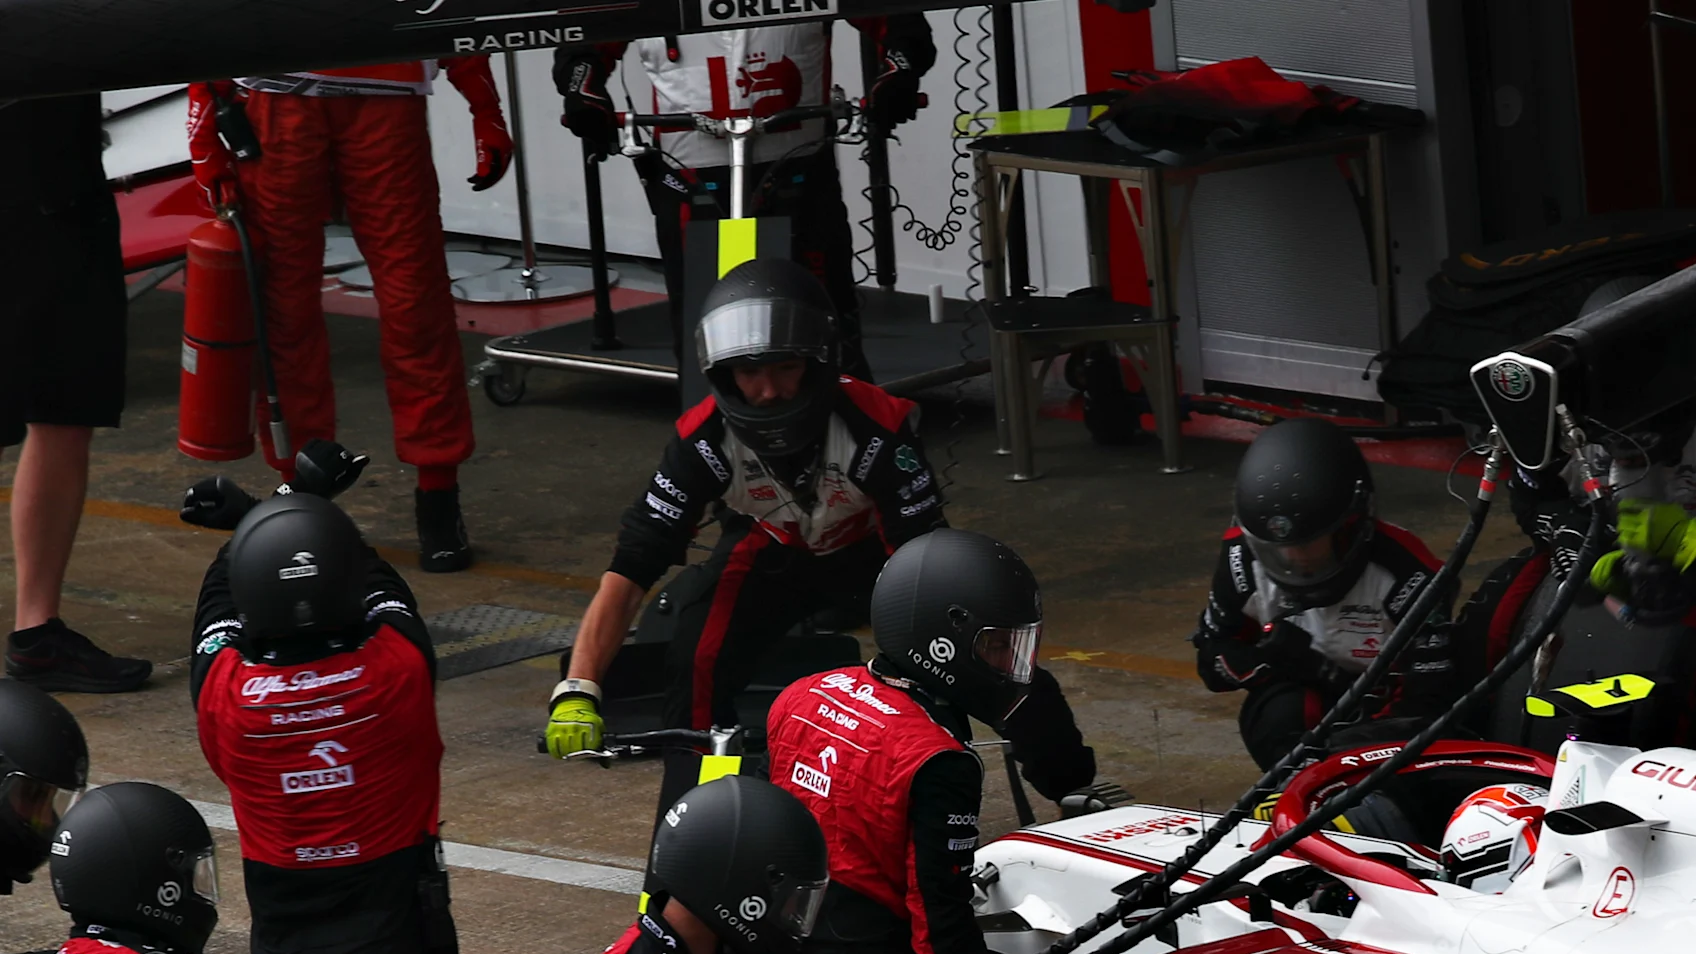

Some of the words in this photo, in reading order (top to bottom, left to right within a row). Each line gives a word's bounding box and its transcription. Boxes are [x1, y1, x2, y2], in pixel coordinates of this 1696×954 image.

[452, 26, 585, 53] RACING
[907, 648, 956, 686] IQONIQ
[241, 676, 283, 704] Alfa
[283, 665, 367, 692] Romeo
[820, 673, 857, 698] Alfa
[271, 705, 346, 726] RACING
[817, 703, 861, 732] RACING
[286, 769, 350, 790] ORLEN
[796, 767, 829, 795] ORLEN
[1090, 816, 1202, 843] HUSKI
[294, 842, 361, 862] sparco
[713, 903, 758, 942] IQONIQ
